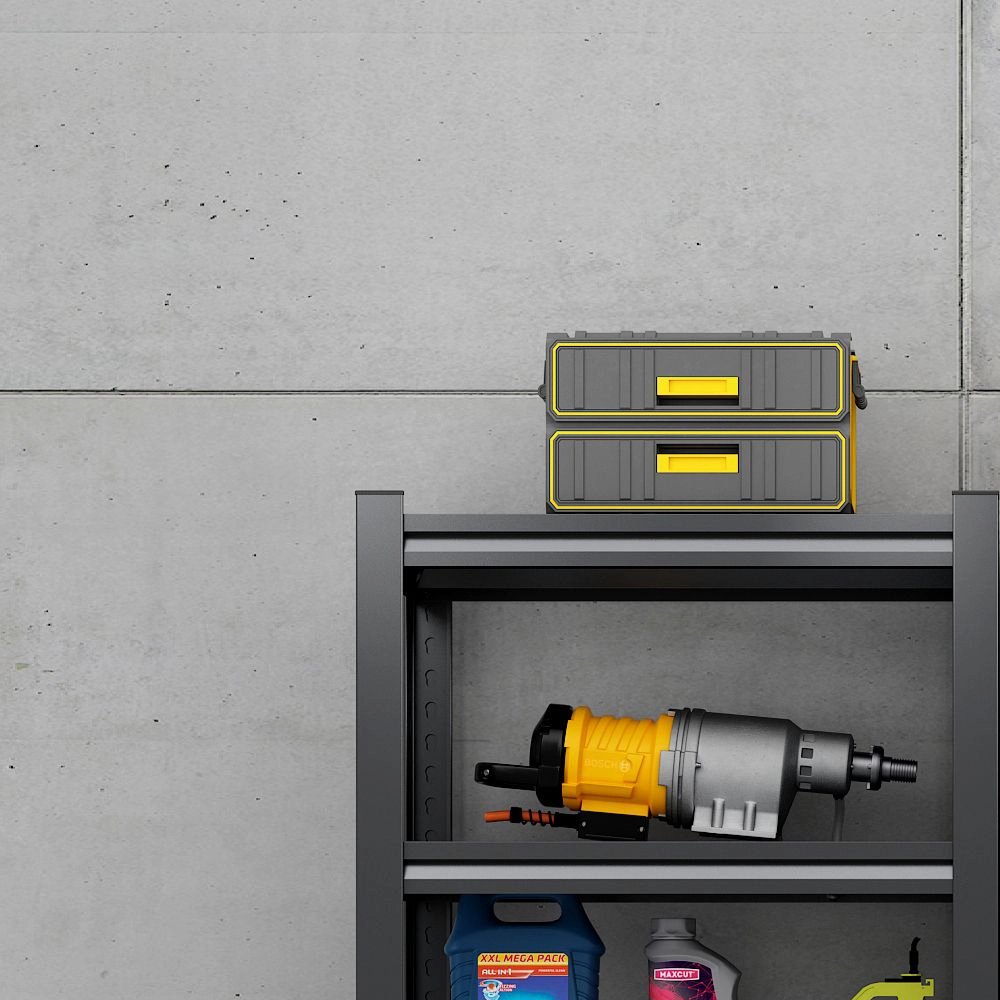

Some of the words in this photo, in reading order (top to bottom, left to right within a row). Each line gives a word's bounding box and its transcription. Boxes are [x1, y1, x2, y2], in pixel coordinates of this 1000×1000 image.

[480, 954, 501, 963] XXL
[504, 954, 533, 963] MEGA
[537, 954, 565, 963] PACK
[660, 970, 693, 978] MAXCUT
